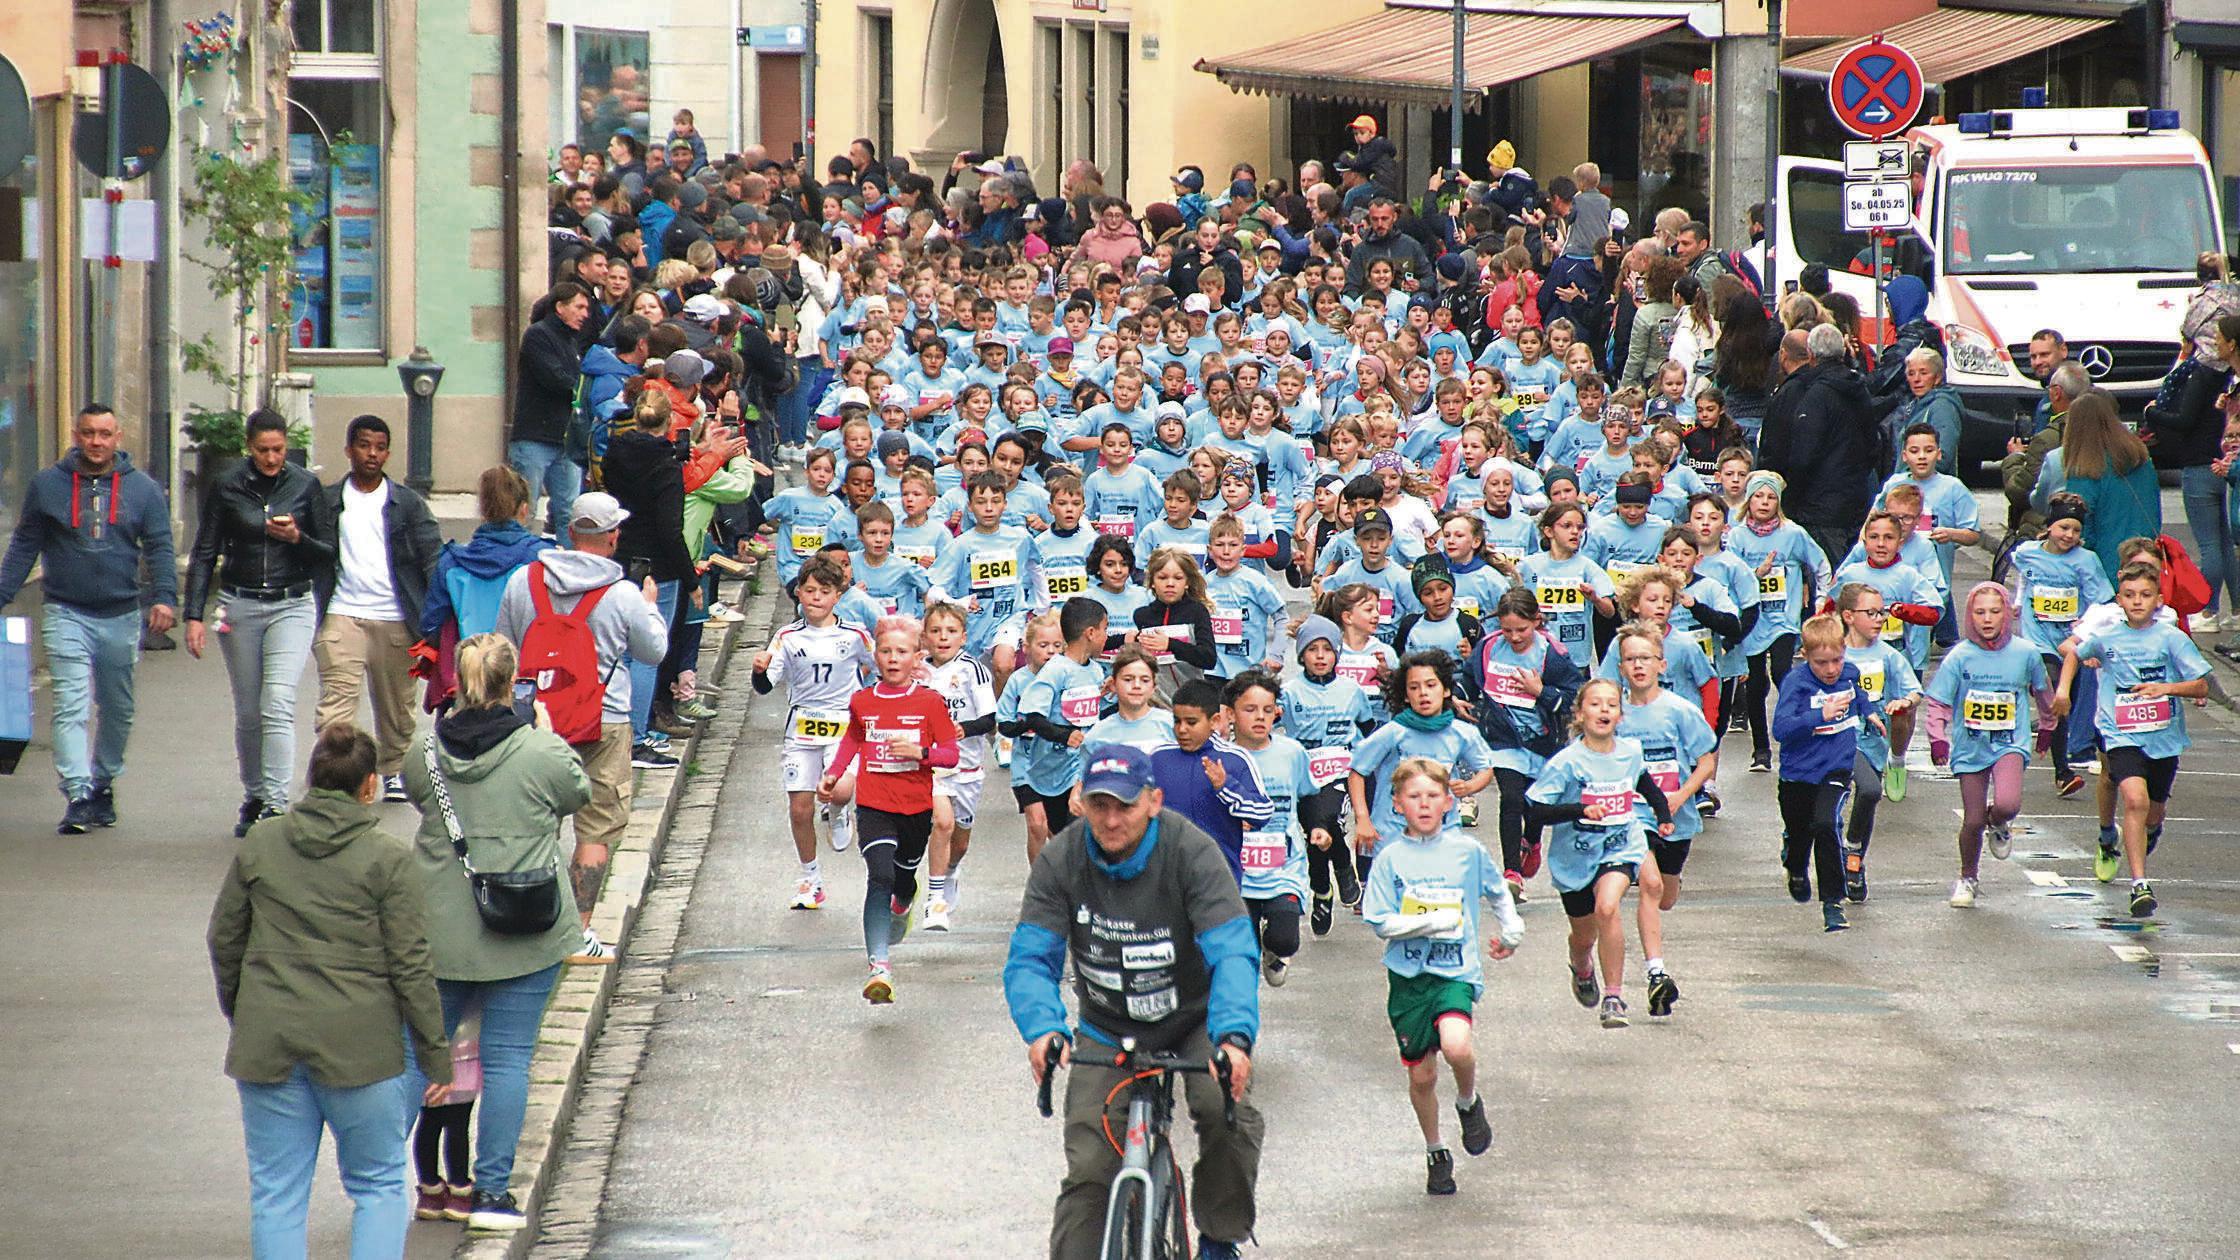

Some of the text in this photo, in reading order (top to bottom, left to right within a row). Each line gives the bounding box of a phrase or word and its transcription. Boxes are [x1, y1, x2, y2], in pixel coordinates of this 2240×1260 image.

[2005, 172, 2037, 182] 72/70
[1872, 188, 1883, 197] ab
[1867, 199, 1905, 210] 04.05.25
[1869, 212, 1889, 222] 06 h
[799, 536, 823, 548] 234
[978, 560, 1012, 580] 264
[1047, 577, 1081, 594] 265
[1759, 577, 1780, 593] 59
[1543, 588, 1577, 604] 278
[2043, 599, 2070, 613] 242
[811, 663, 833, 684] 17
[1496, 677, 1516, 694] 35
[1970, 702, 2008, 721] 255
[2127, 705, 2158, 721] 485
[804, 719, 841, 738] 267
[876, 744, 905, 760] 32
[1240, 848, 1273, 866] 318
[1403, 940, 1422, 960] be
